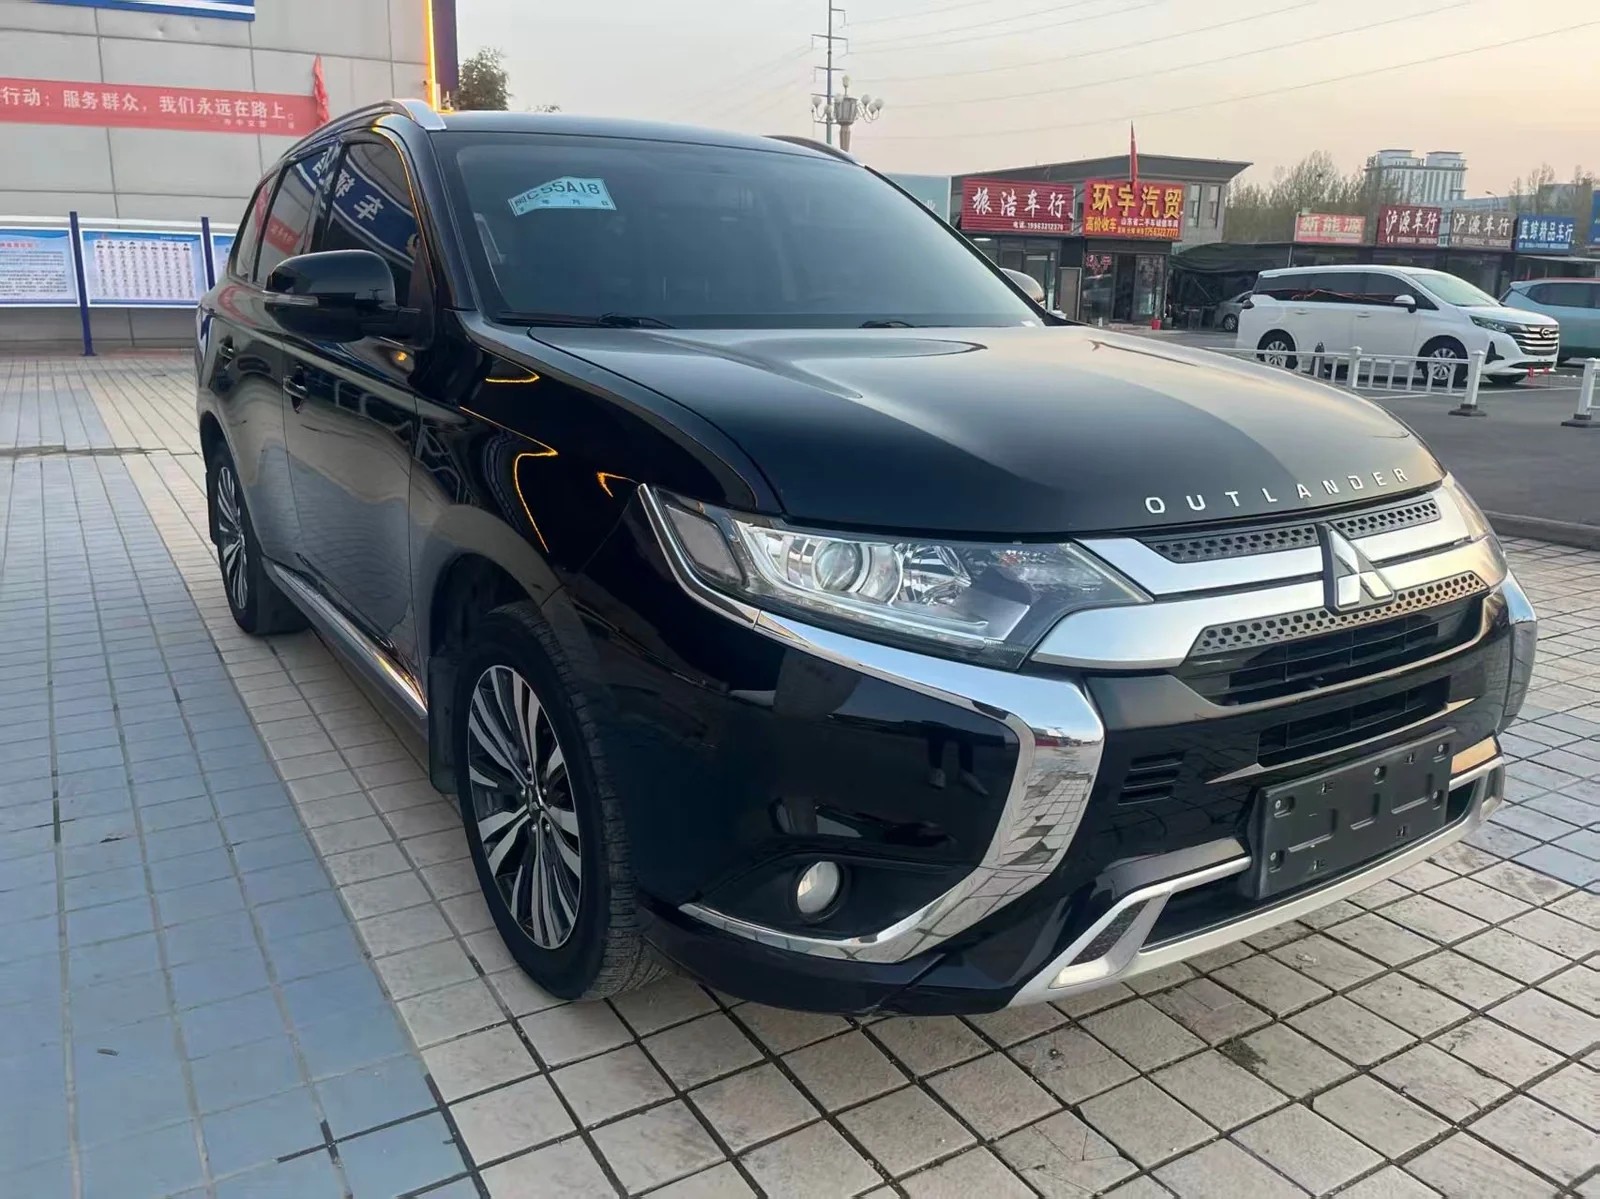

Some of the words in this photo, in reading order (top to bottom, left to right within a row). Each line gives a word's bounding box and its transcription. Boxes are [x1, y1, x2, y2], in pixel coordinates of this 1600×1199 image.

[0, 86, 294, 120] 行动:服务群众,我们永远在路上。
[1093, 184, 1182, 219] 环宇汽贸
[1145, 468, 1408, 514] OUTLANDER
